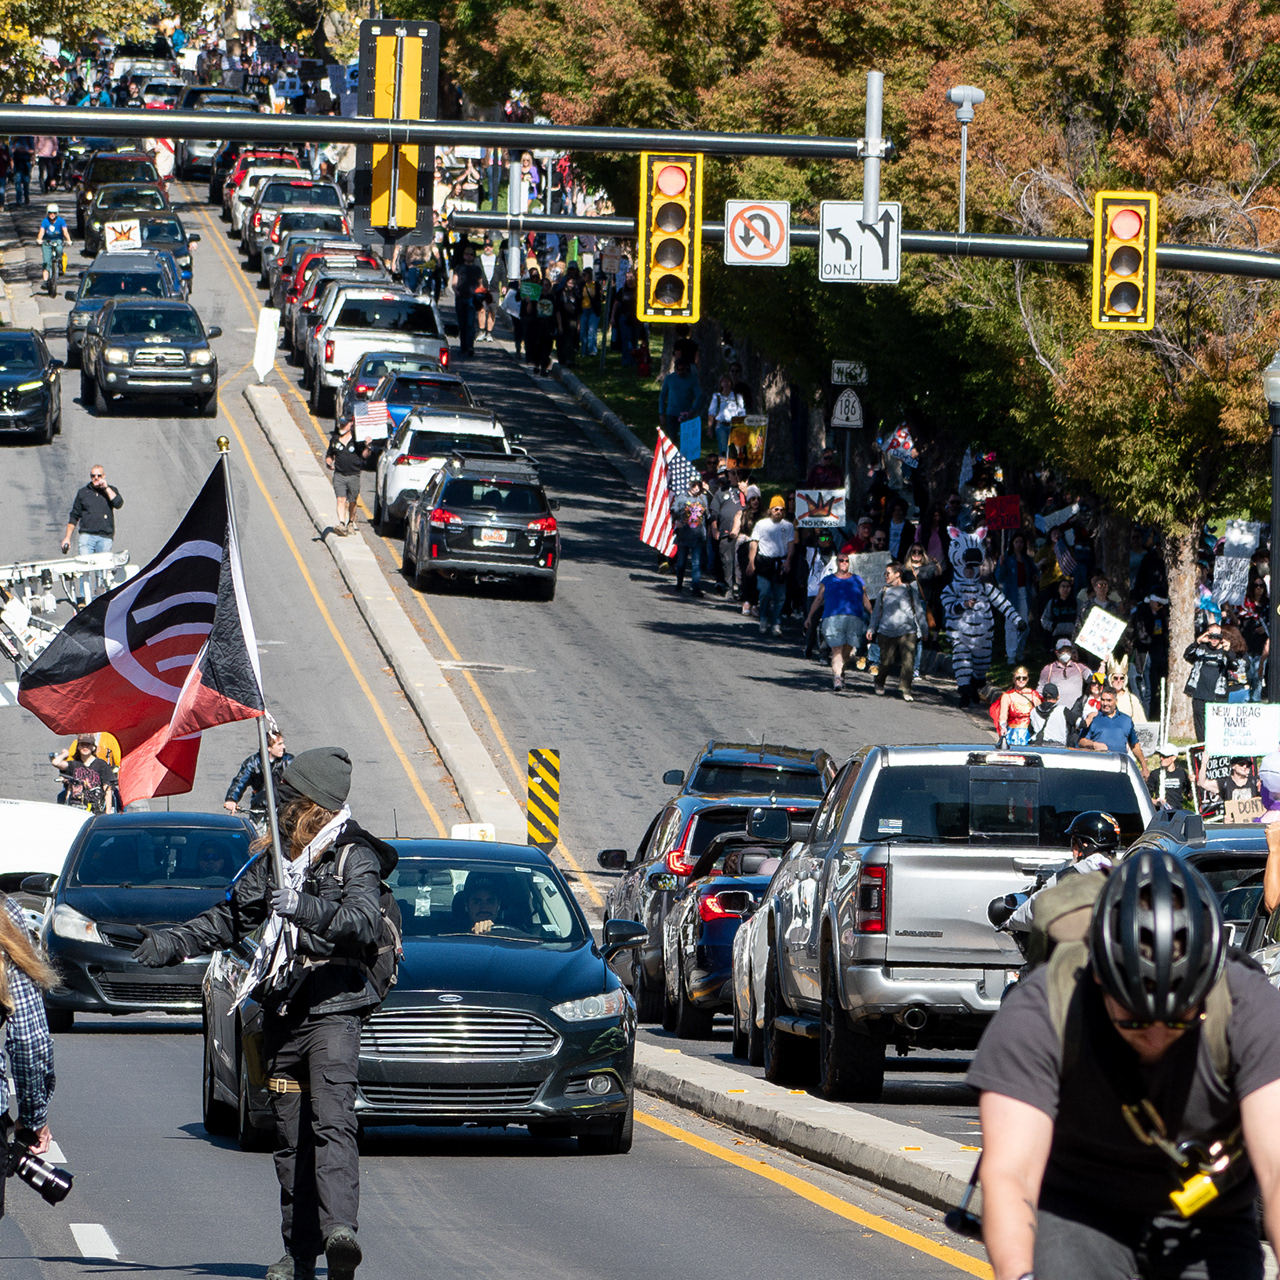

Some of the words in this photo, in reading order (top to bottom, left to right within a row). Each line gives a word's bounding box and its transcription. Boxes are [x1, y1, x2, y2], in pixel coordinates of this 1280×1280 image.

[824, 264, 858, 276] ONLY
[840, 398, 856, 416] 186
[1212, 706, 1231, 717] NEW
[1236, 706, 1261, 718] DRAG
[1224, 717, 1250, 727] NAME:
[1206, 759, 1218, 770] OR
